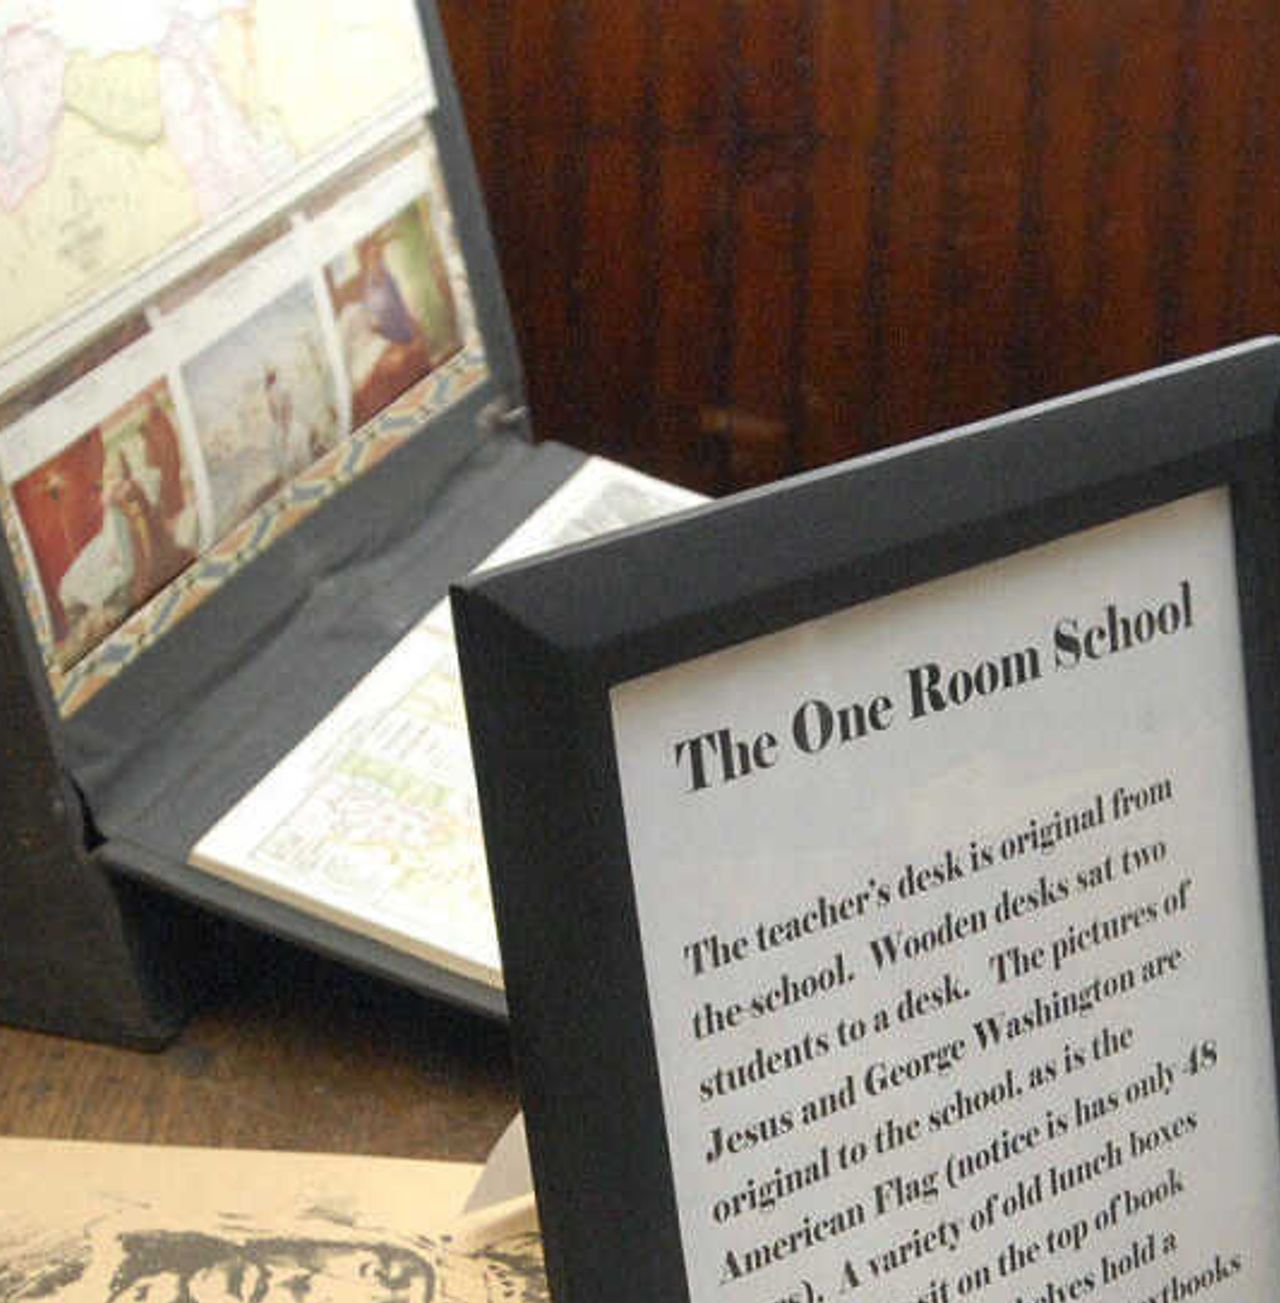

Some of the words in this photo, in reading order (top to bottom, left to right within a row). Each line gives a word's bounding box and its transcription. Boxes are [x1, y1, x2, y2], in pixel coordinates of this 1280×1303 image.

[672, 727, 779, 793] The
[790, 694, 894, 755] One
[904, 646, 1043, 721] Room
[1052, 578, 1194, 673] School
[682, 933, 749, 977] The
[754, 876, 891, 952] teacher's
[896, 848, 965, 900] desk
[968, 839, 995, 873] is
[998, 793, 1106, 861] original
[1110, 777, 1173, 821] from
[691, 1001, 747, 1041] the
[749, 950, 856, 1019] school.
[868, 908, 988, 971] Wooden
[993, 874, 1070, 924] desks
[1075, 854, 1113, 892] sat
[1120, 839, 1167, 876] two
[698, 1031, 830, 1103] students
[835, 1017, 867, 1048] to
[872, 1007, 891, 1034] a
[895, 972, 971, 1023] desk.
[987, 944, 1045, 985] The
[1050, 901, 1158, 972] pictures
[1161, 876, 1193, 916] of
[704, 1109, 795, 1165] Jesus
[800, 1073, 857, 1126] and
[862, 1038, 966, 1097] George
[971, 967, 1136, 1051] Washington
[1140, 947, 1182, 984] are
[711, 1144, 831, 1225] original
[836, 1140, 868, 1171] to
[873, 1117, 921, 1155] the
[1027, 1058, 1058, 1090] as
[1062, 1042, 1086, 1075] is
[1090, 1026, 1134, 1062] the
[718, 1202, 866, 1286] American
[871, 1169, 940, 1217] Flag
[944, 1124, 1041, 1189] (notice
[1044, 1108, 1069, 1141] is
[1073, 1090, 1120, 1128] has
[1123, 1059, 1174, 1105] only
[1180, 1038, 1218, 1077] 48
[838, 1258, 861, 1295] A
[865, 1219, 961, 1278] variety
[968, 1191, 1000, 1233] of
[1000, 1172, 1043, 1218] old
[1046, 1138, 1123, 1197] lunch
[1128, 1111, 1198, 1159] boxes
[955, 1264, 992, 1297] on
[996, 1240, 1041, 1278] the
[1044, 1218, 1089, 1255] top
[1092, 1192, 1122, 1232] of
[1122, 1167, 1185, 1217] book
[1099, 1232, 1156, 1286] hold
[1161, 1231, 1178, 1256] a
